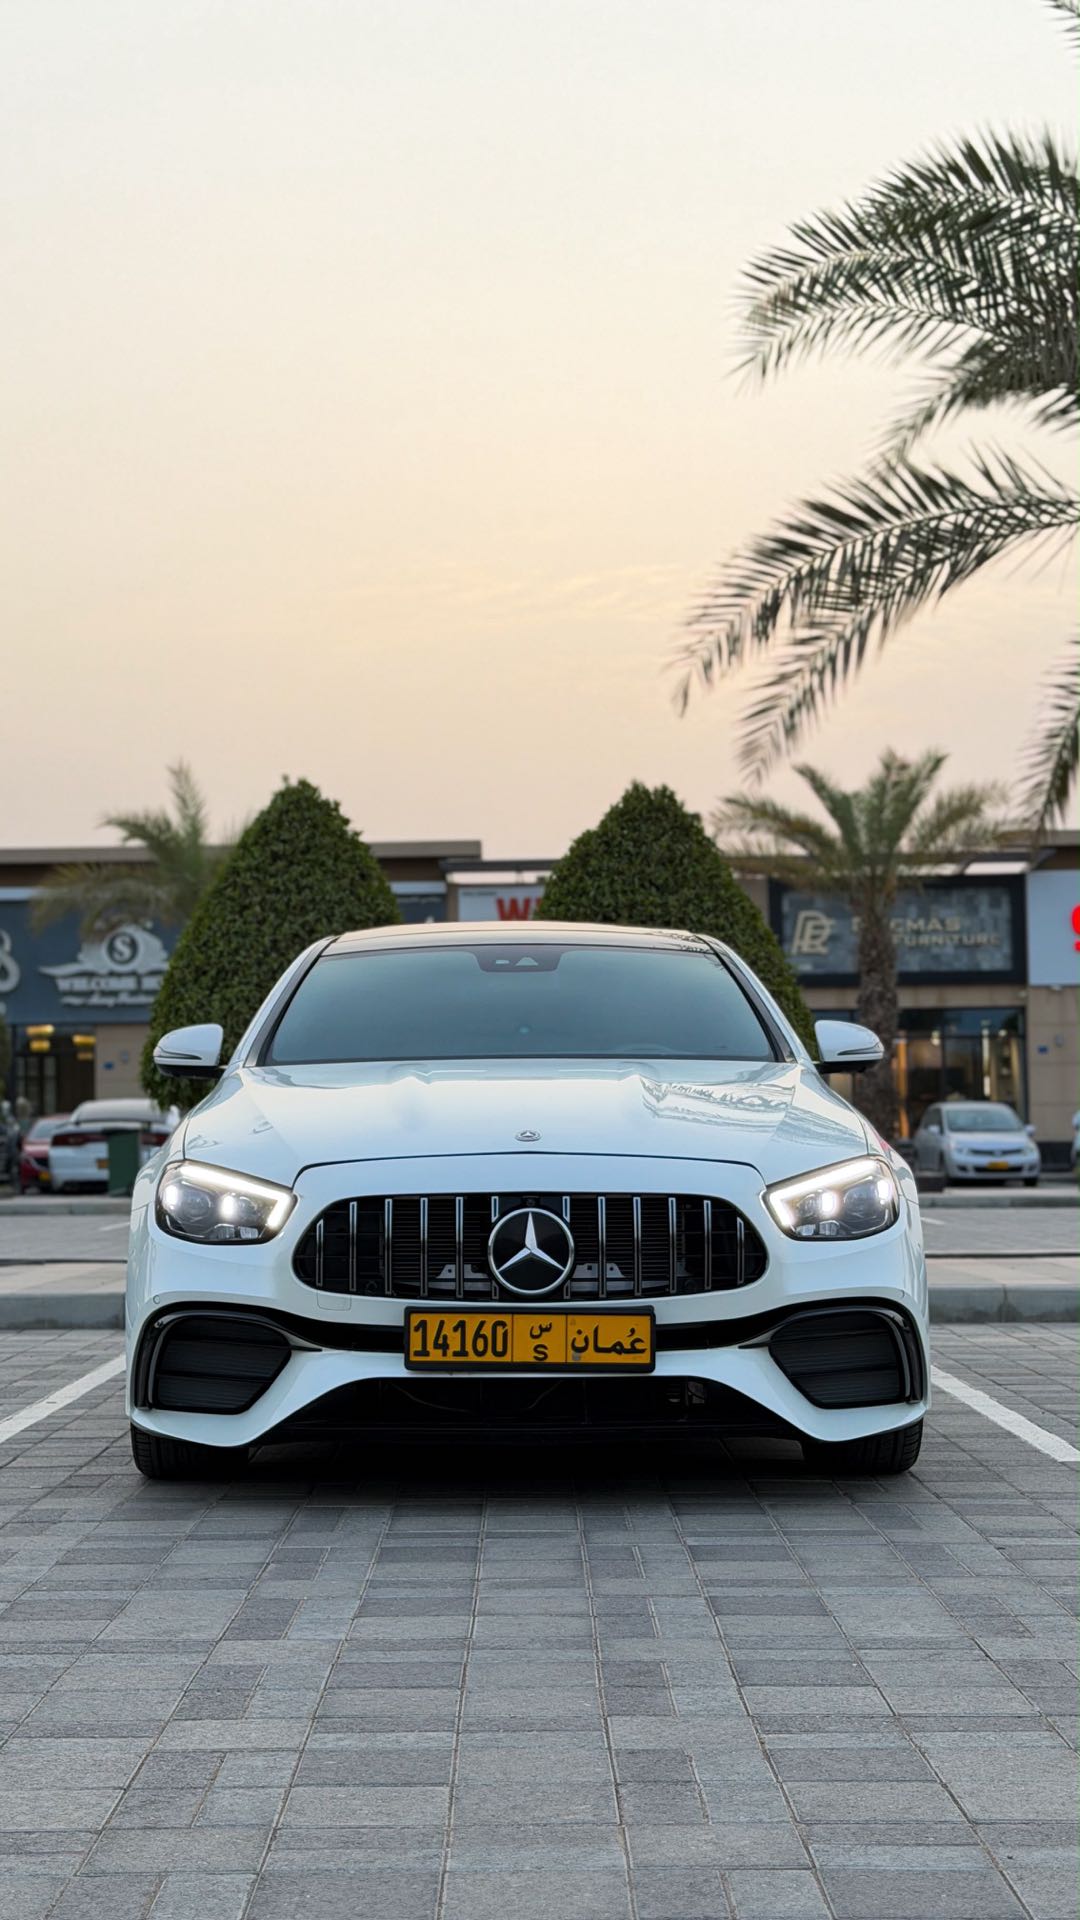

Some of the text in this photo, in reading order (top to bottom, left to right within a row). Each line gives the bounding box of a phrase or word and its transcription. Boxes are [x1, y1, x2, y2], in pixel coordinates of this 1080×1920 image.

[893, 932, 1000, 947] FURNITURE
[111, 935, 132, 962] S
[55, 975, 137, 992] WELCOME
[413, 1319, 508, 1358] 14160
[529, 1322, 553, 1339] س
[533, 1343, 548, 1361] S
